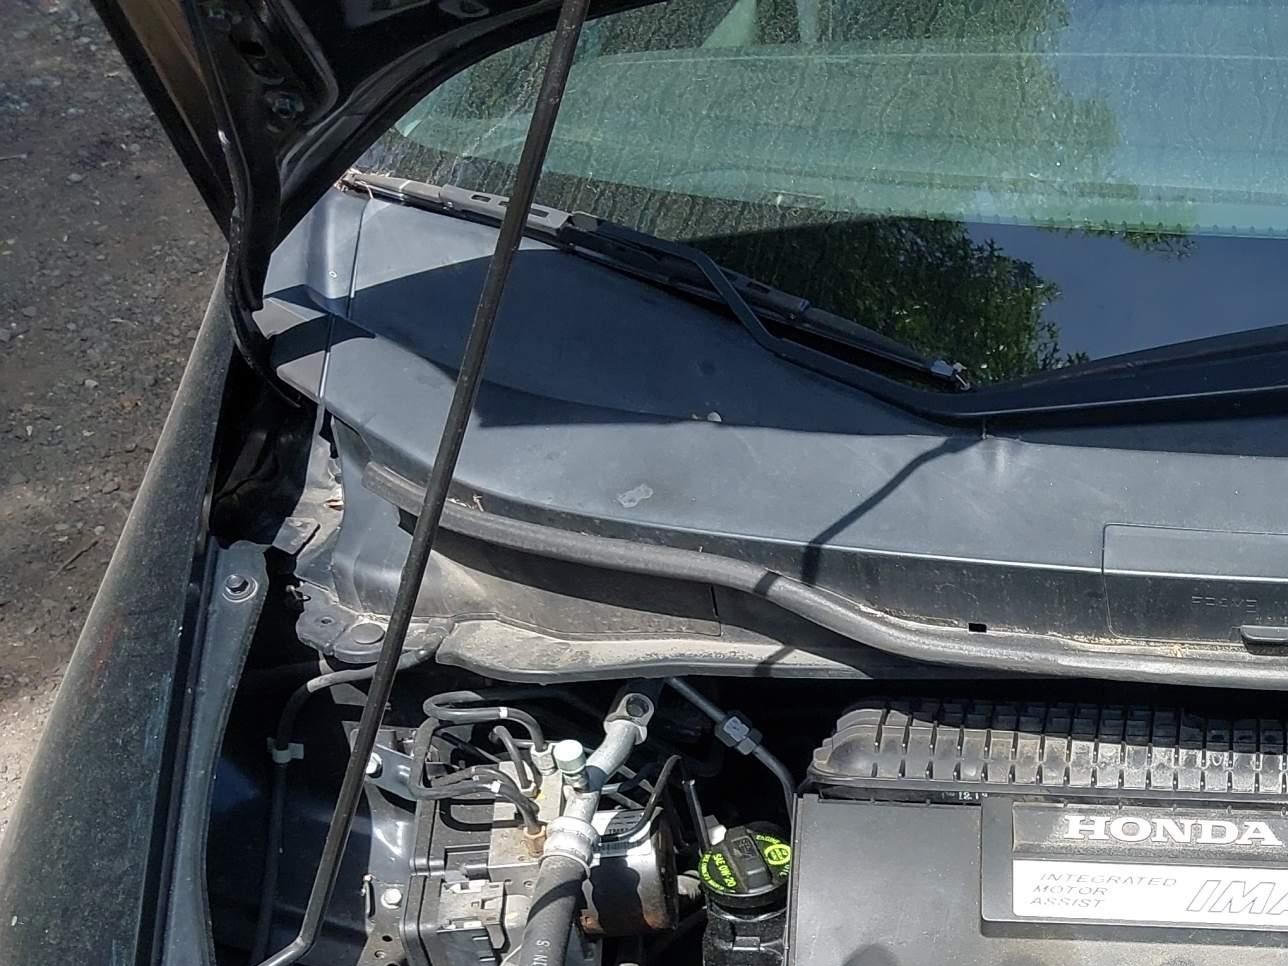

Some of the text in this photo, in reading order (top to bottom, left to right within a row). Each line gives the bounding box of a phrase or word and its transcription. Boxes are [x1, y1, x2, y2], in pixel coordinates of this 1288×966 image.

[1063, 815, 1286, 847] HONDA
[1040, 873, 1177, 888] INTEGRATED
[1033, 886, 1108, 897] MOTOR
[1030, 897, 1104, 909] ASSIST
